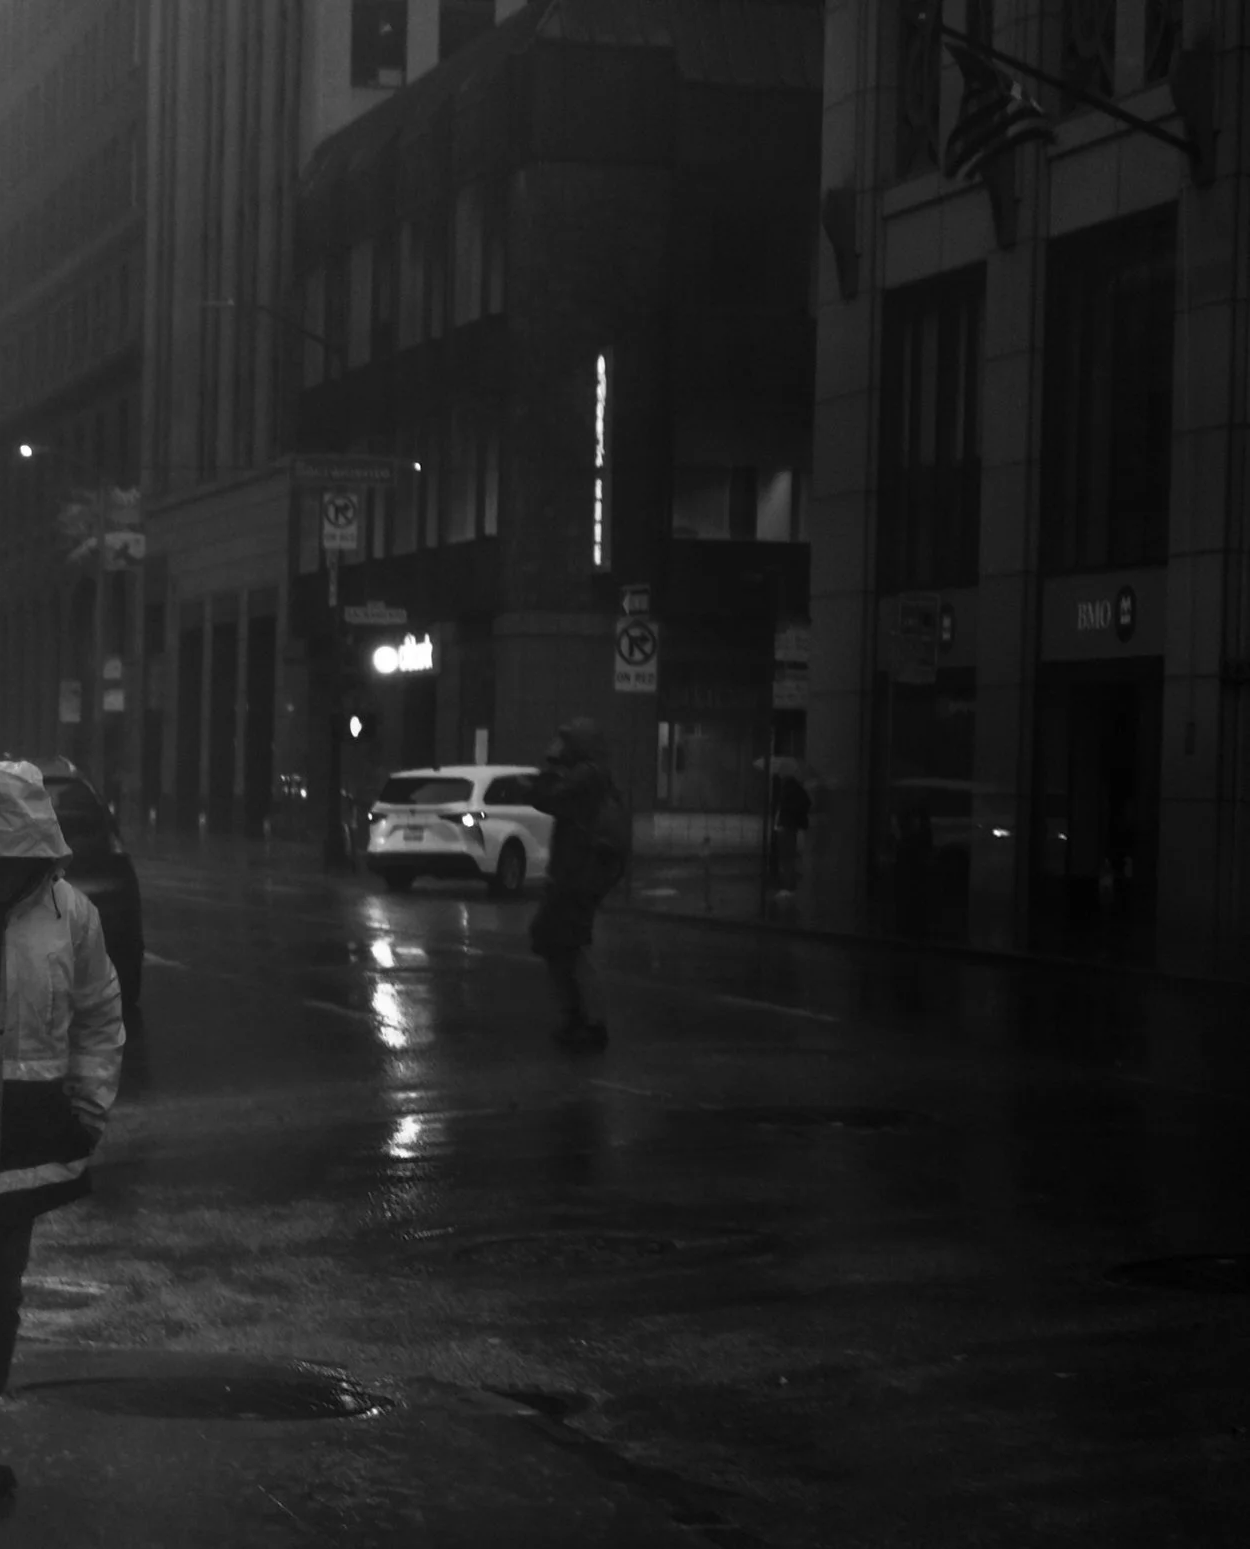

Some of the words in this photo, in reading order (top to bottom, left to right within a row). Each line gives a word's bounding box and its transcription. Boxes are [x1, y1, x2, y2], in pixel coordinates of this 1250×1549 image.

[1077, 598, 1112, 630] BMO
[616, 672, 631, 684] ON
[635, 672, 654, 685] RED
